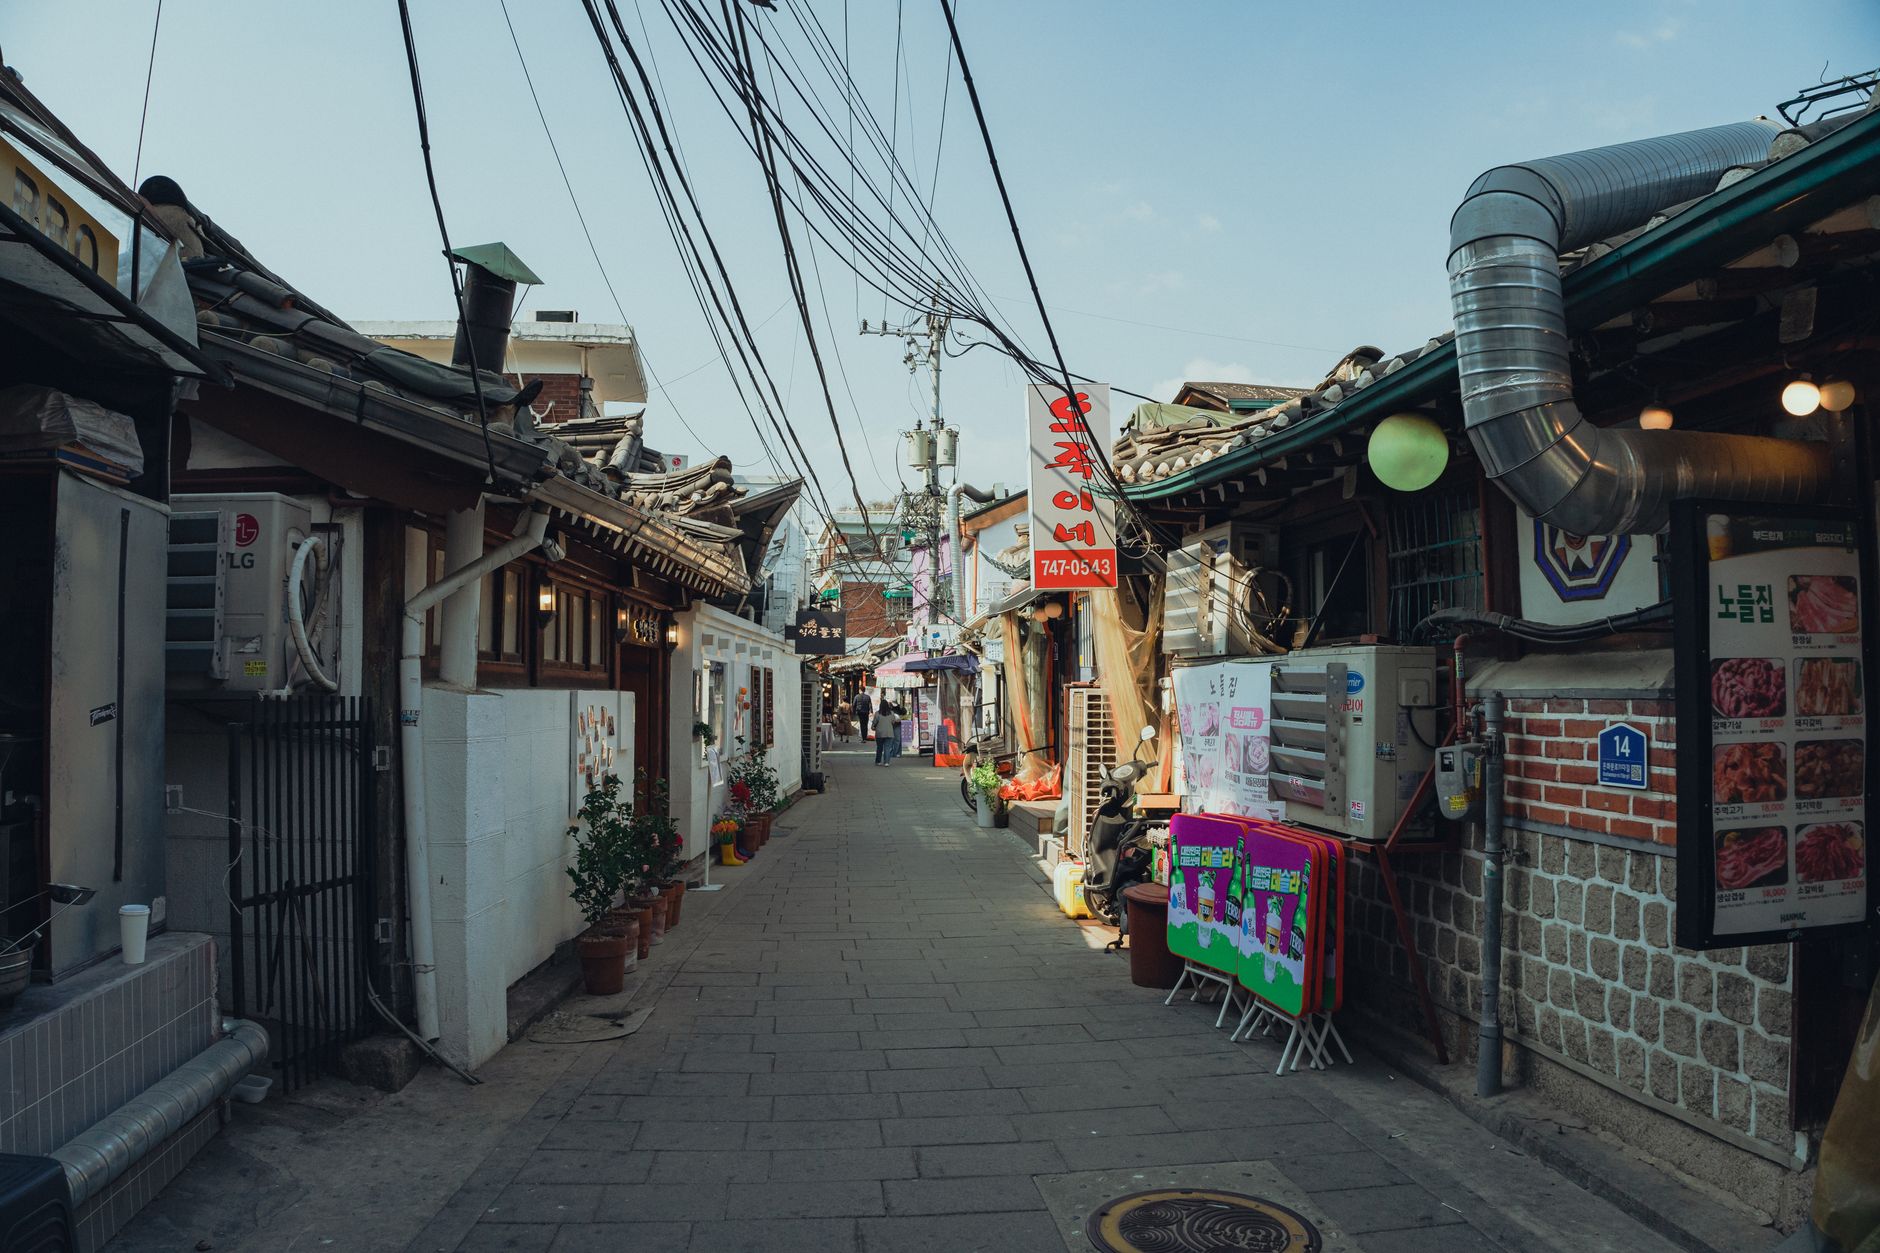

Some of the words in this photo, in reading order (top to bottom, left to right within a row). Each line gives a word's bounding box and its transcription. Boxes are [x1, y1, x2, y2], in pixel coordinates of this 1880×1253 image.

[229, 552, 254, 569] LG
[1041, 558, 1111, 577] 747-0543
[1717, 584, 1775, 623] 노들집
[1209, 673, 1238, 698] 노들집
[1795, 718, 1823, 727] 돼지갈비
[1613, 735, 1631, 758] 14
[1714, 805, 1744, 815] 주먹고기
[1797, 885, 1824, 895] 소갈비살
[1841, 880, 1865, 890] 22,000
[1717, 892, 1745, 903] 생삼겹살
[1780, 911, 1807, 923] HANMAC
